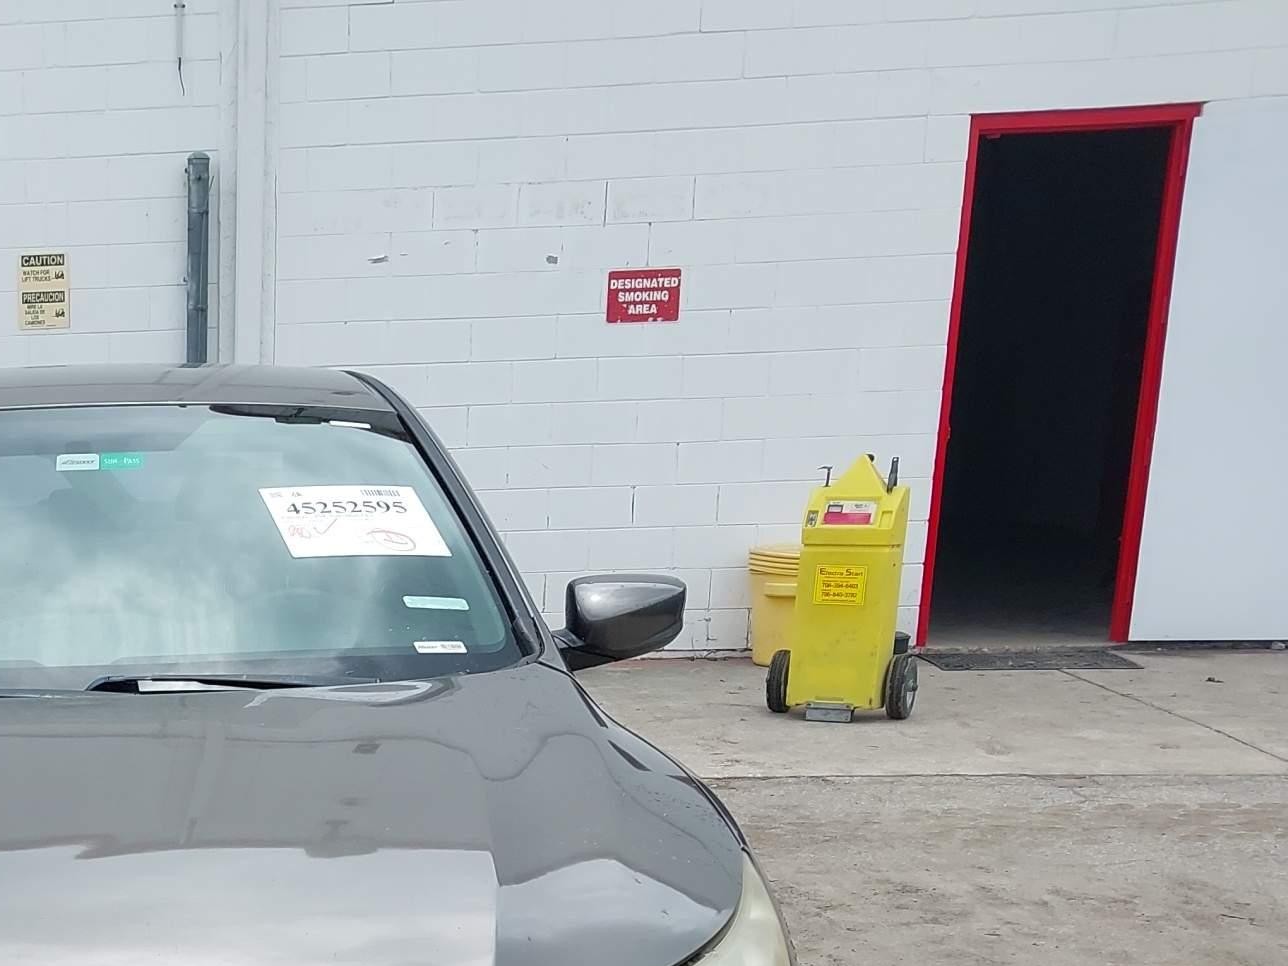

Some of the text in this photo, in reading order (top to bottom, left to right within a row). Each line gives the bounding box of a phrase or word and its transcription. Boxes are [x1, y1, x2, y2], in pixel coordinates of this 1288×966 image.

[22, 255, 64, 266] CAUTION
[610, 277, 679, 290] DESIGNATED
[617, 290, 670, 302] SMOKING
[628, 303, 658, 315] AREA
[287, 501, 409, 515] 45252595
[845, 568, 864, 577] Start
